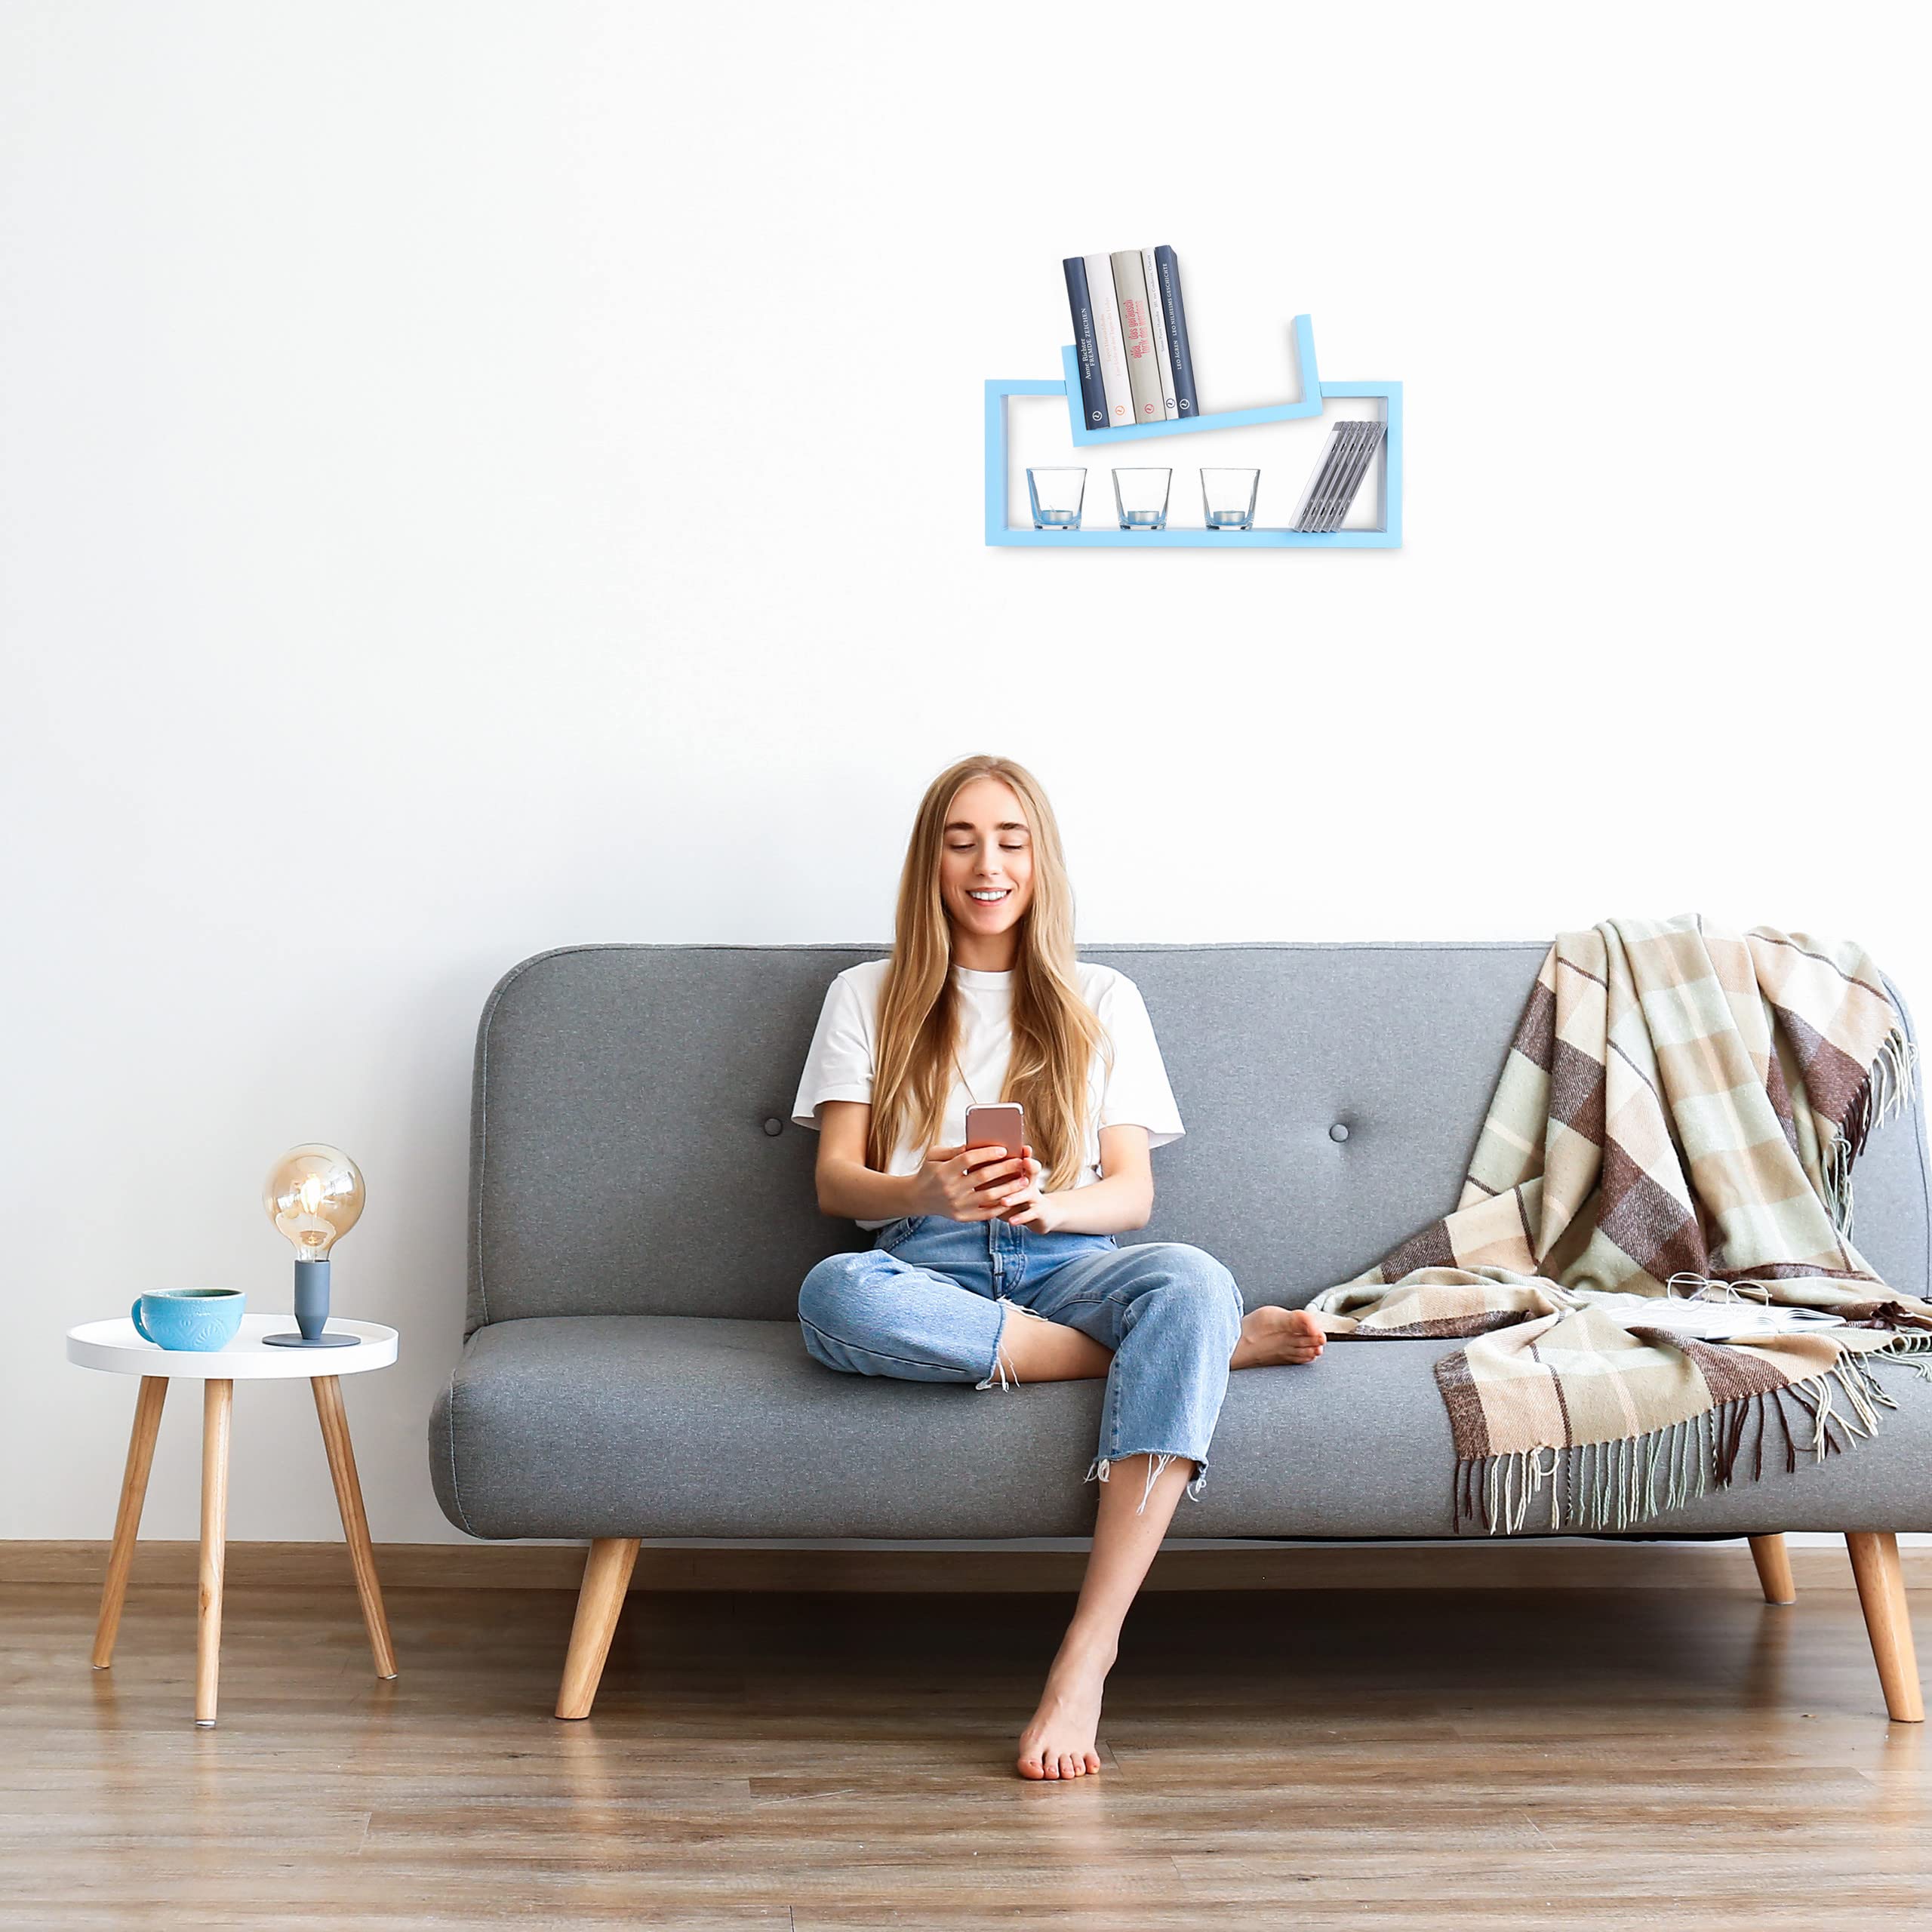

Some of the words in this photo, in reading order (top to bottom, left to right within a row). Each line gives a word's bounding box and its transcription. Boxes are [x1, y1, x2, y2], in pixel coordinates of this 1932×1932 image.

[1162, 263, 1172, 297] GESCHICHTE
[1081, 308, 1091, 337] ZEICHEN
[1123, 299, 1139, 328] geräusch
[1168, 298, 1176, 325] NILHEIMS
[1128, 328, 1139, 340] das
[1079, 338, 1089, 361] Richter
[1086, 339, 1095, 366] FREMDE
